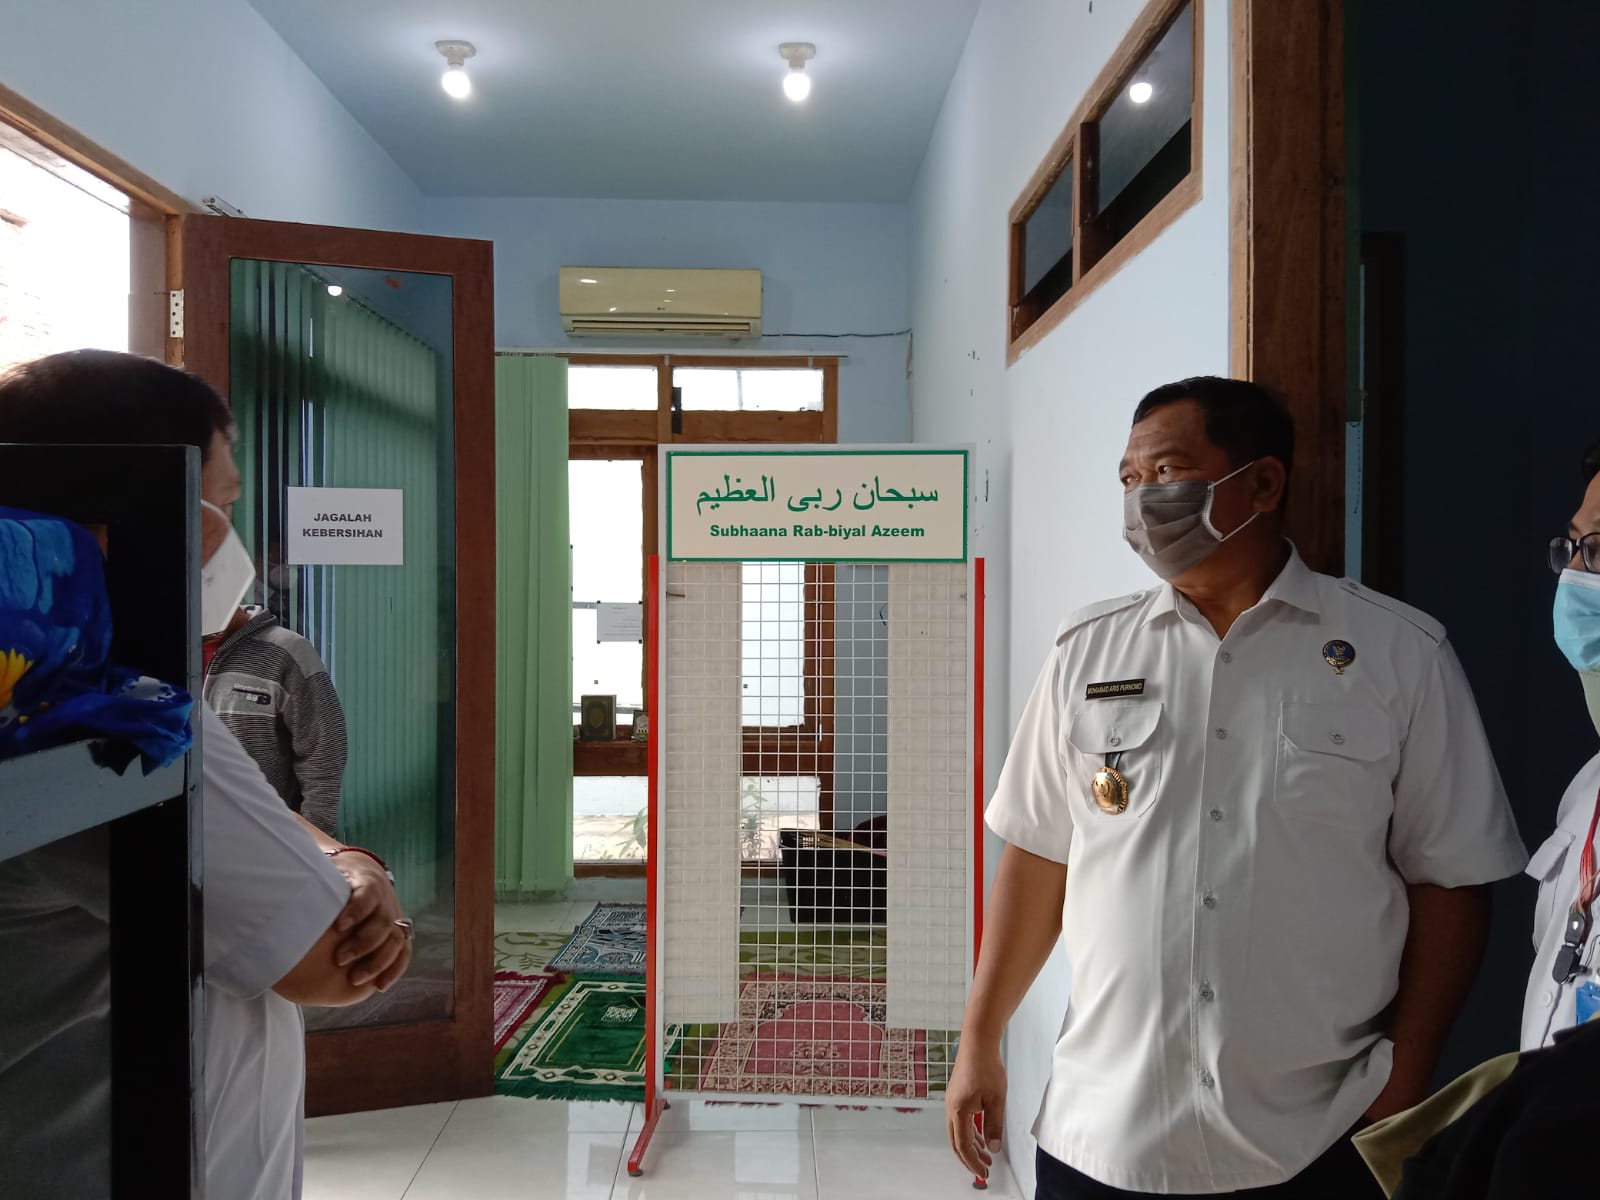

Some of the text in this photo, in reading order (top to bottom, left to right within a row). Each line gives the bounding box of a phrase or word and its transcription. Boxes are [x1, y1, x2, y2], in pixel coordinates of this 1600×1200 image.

[696, 473, 775, 516] العظيم
[852, 475, 939, 510] سبحان
[313, 513, 371, 522] JAGALAH
[302, 528, 383, 538] KEBERSIHAN
[709, 524, 925, 540] Subhaana Rab-biyal Azeem
